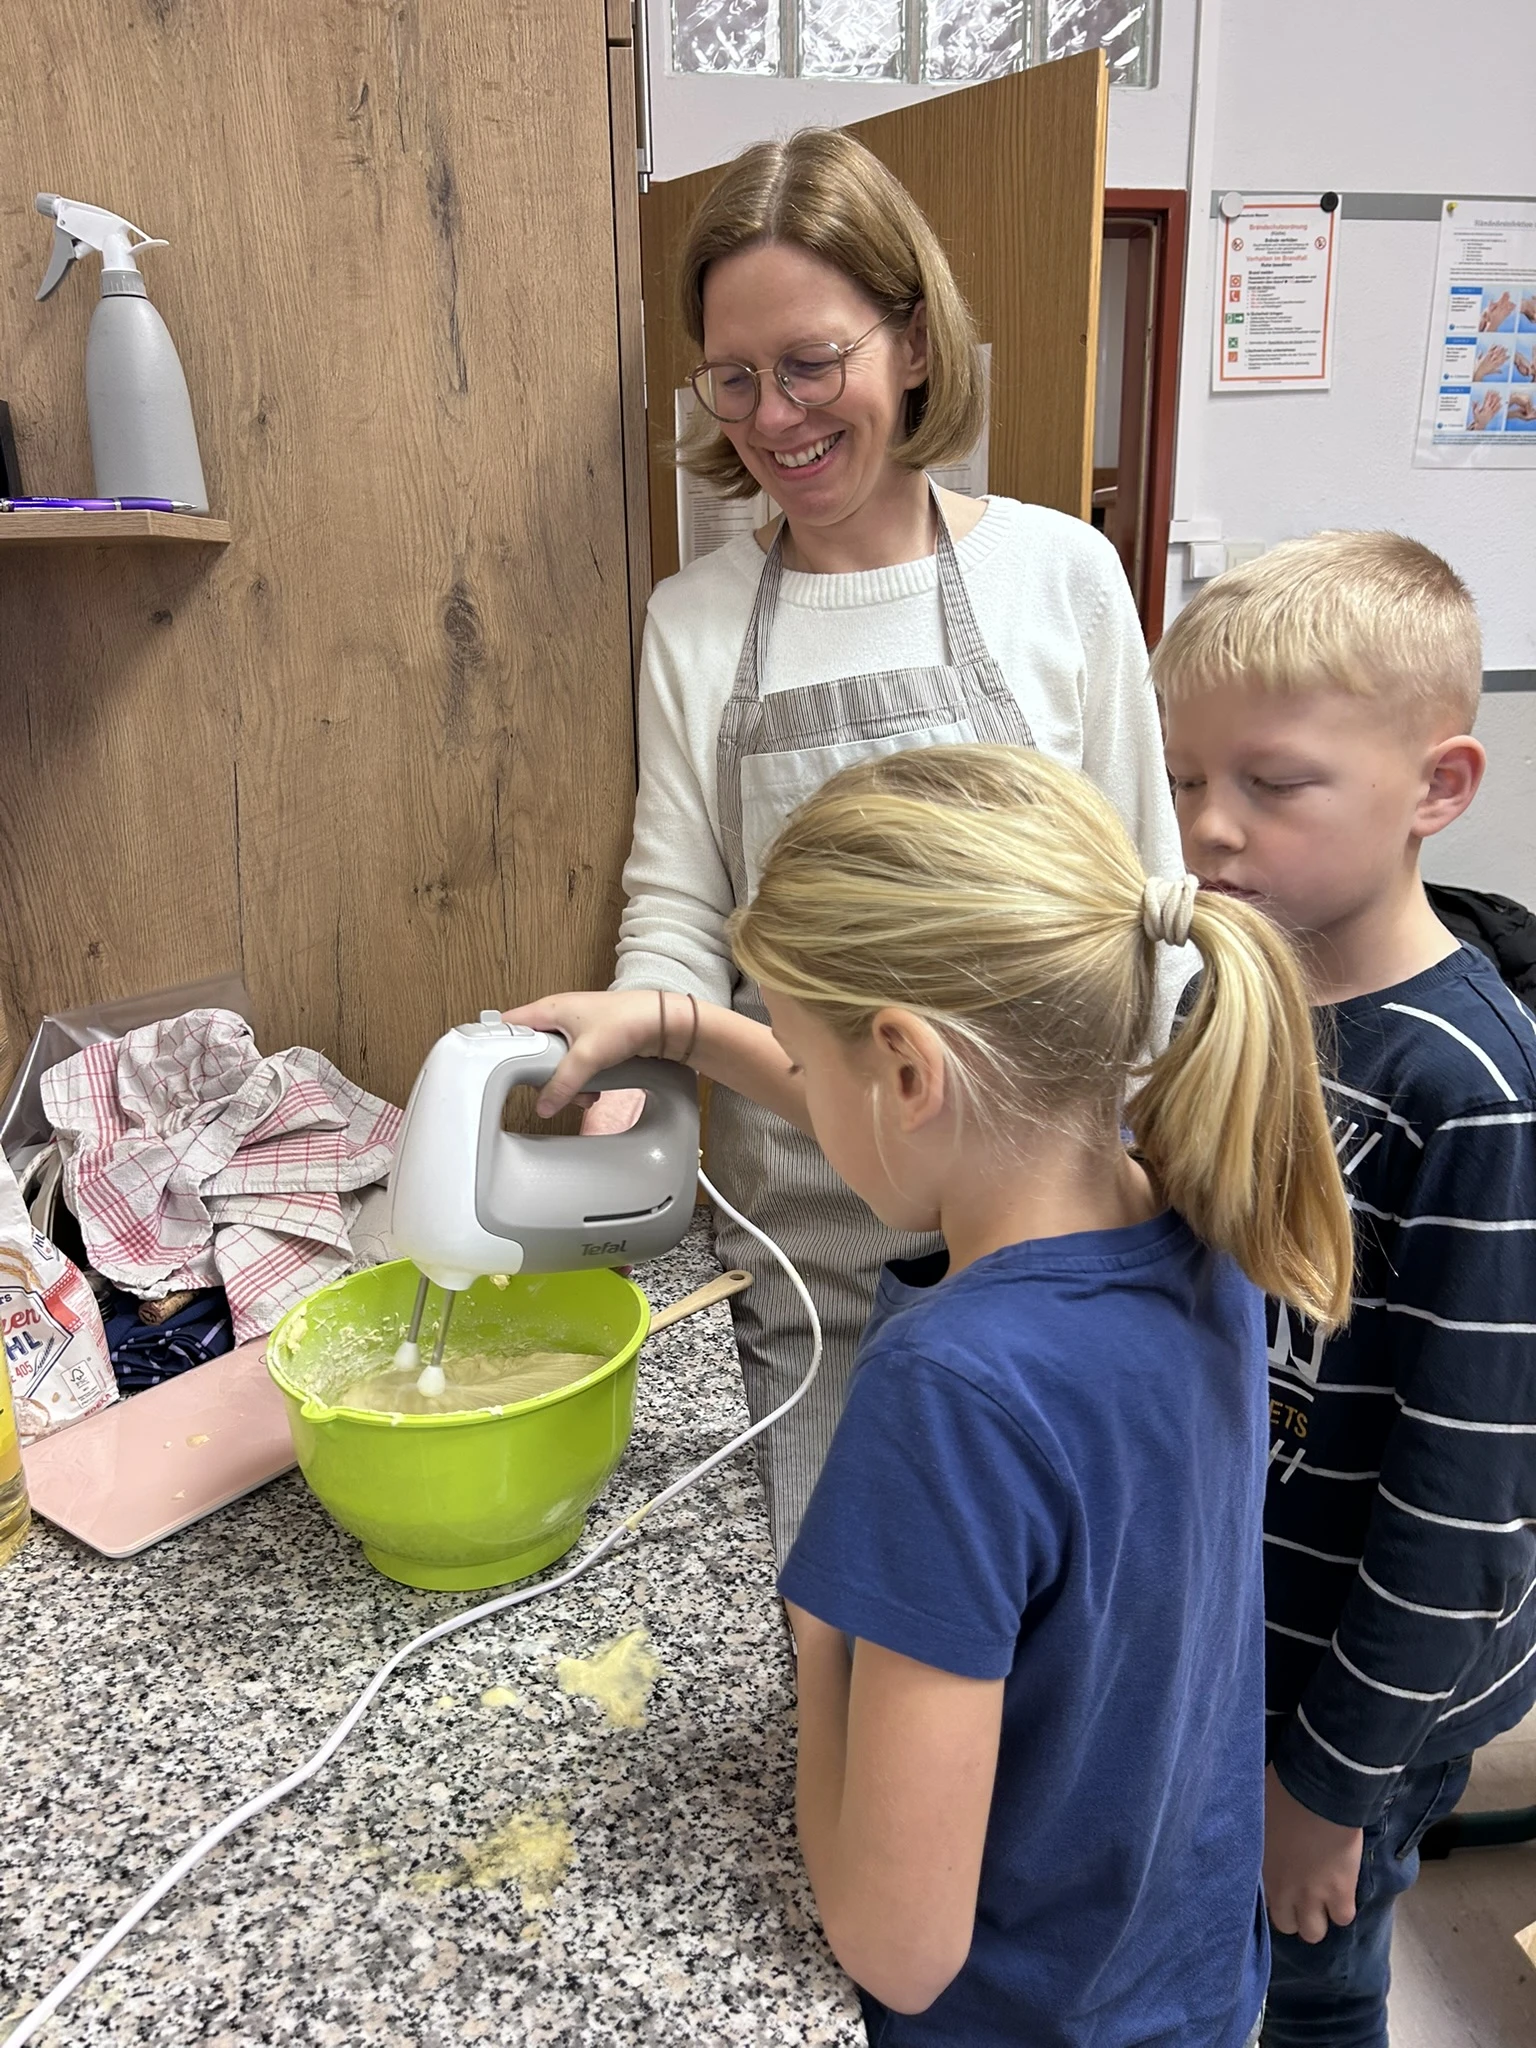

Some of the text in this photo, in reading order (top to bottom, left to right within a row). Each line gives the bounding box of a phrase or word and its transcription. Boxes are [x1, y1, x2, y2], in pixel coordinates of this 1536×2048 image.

[581, 1240, 627, 1256] Tefal
[15, 1360, 34, 1378] 405
[84, 1393, 112, 1417] EDEKA
[1269, 1399, 1308, 1438] ETS
